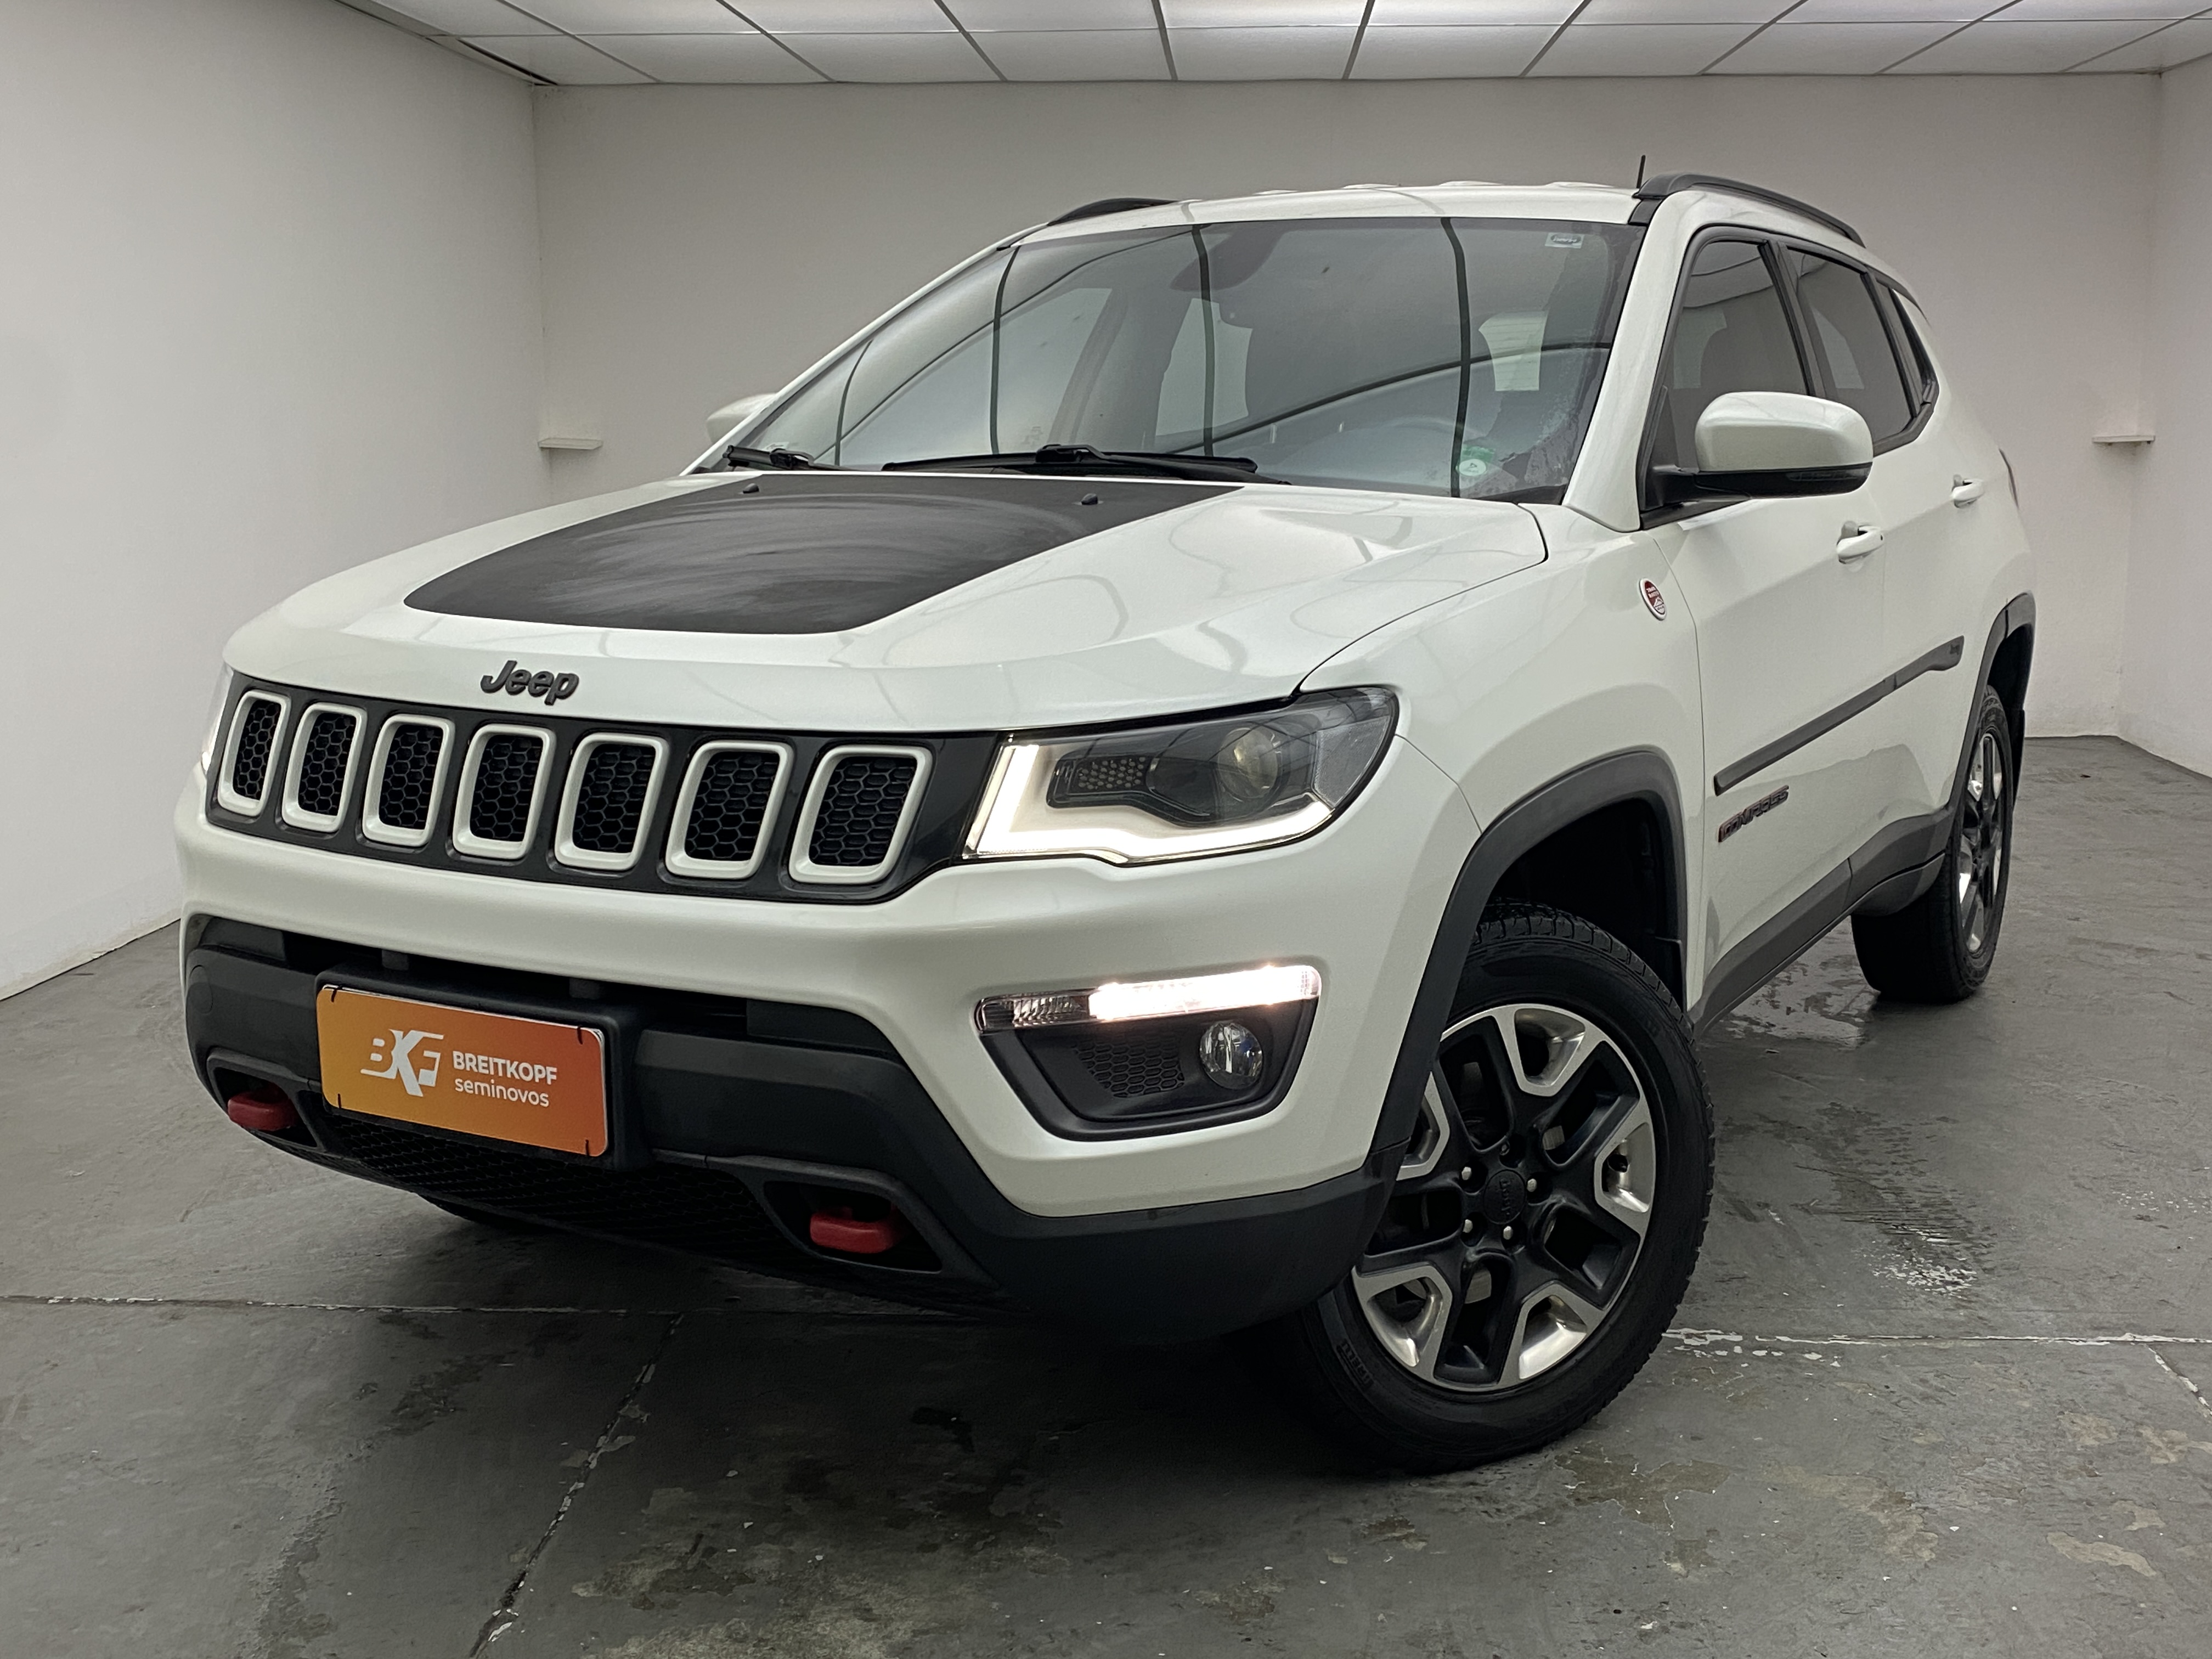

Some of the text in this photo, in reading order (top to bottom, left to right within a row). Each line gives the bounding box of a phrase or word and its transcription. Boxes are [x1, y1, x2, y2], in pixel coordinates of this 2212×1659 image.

[481, 660, 579, 706] Jeep
[453, 1051, 557, 1085] BREITKOPF
[455, 1077, 550, 1107] seminovos
